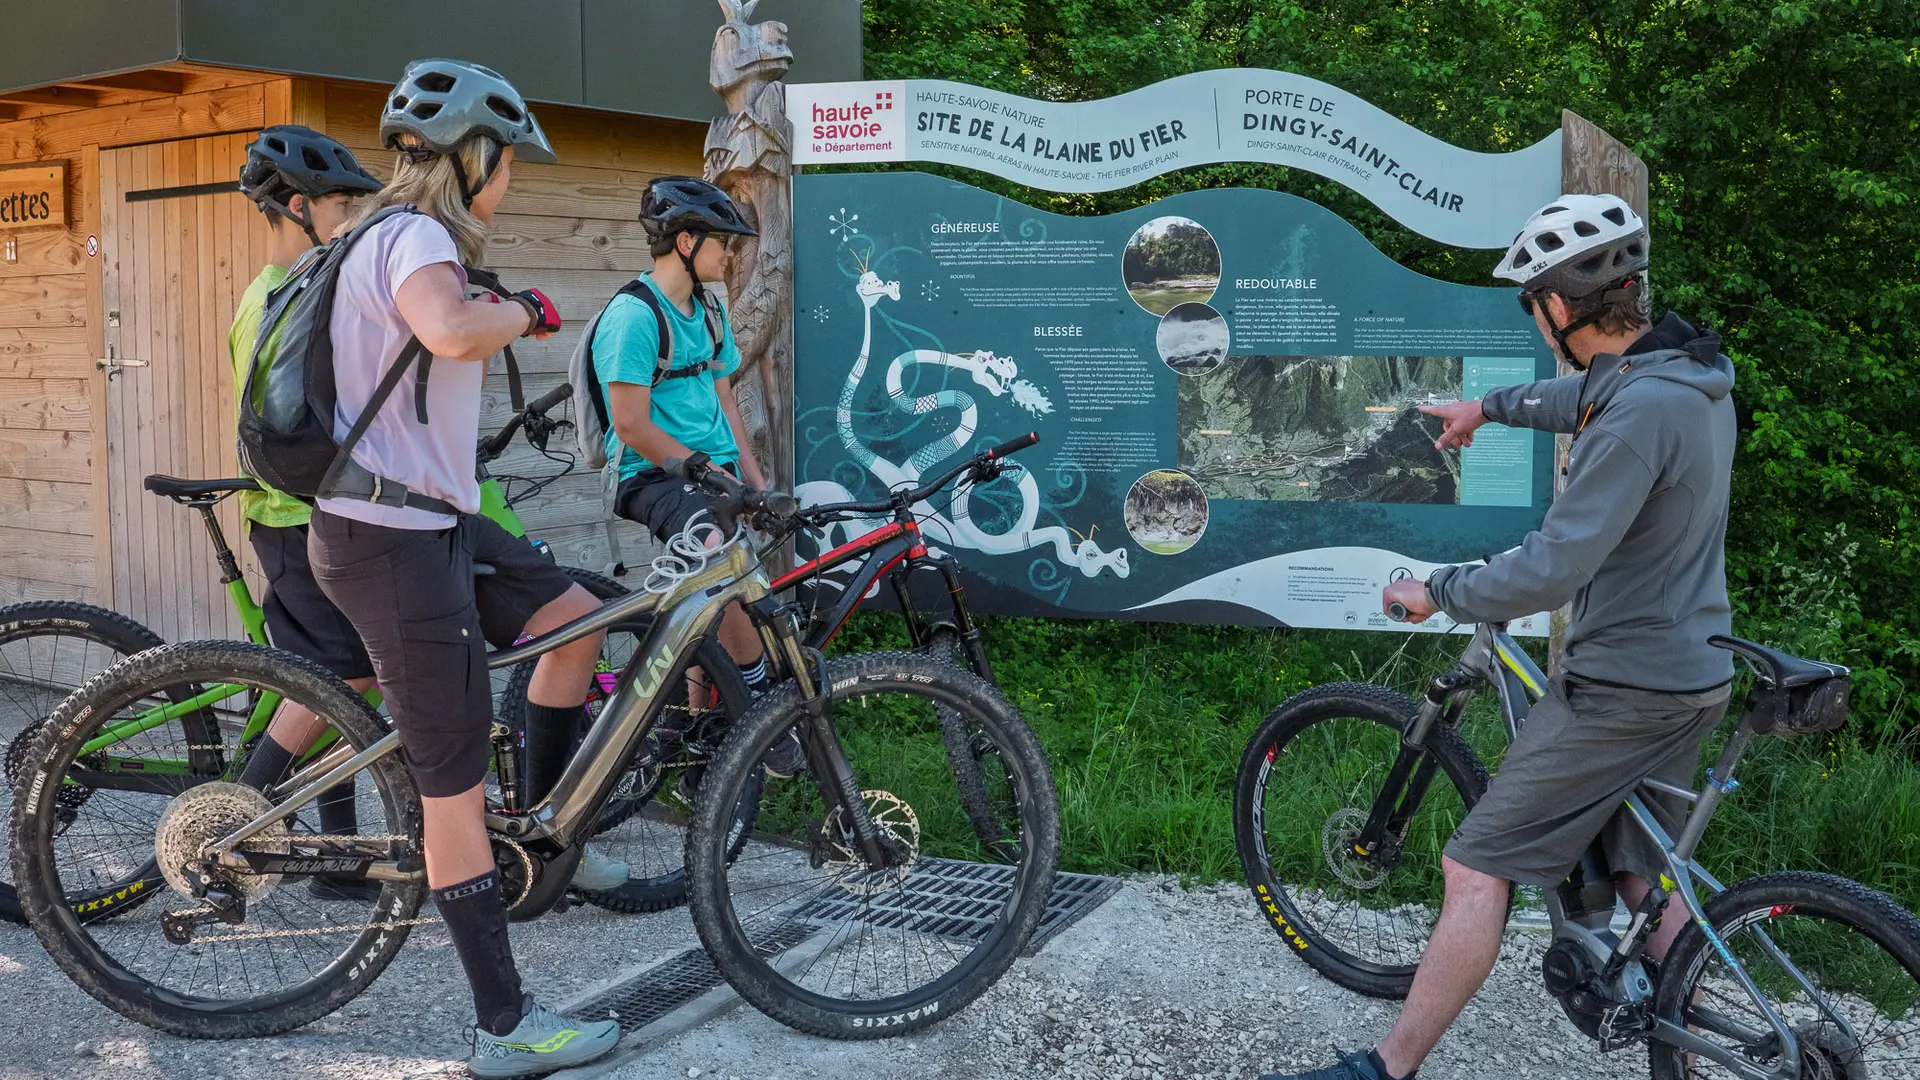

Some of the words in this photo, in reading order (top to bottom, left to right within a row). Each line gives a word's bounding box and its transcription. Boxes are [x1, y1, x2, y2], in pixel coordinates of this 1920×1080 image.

[812, 101, 873, 122] haute
[916, 92, 999, 113] HAUTE-SAVOIE
[1000, 105, 1045, 128] NATURE
[1245, 89, 1305, 109] PORTE
[1308, 97, 1336, 117] DE
[813, 122, 882, 140] savoie
[917, 111, 961, 134] SITE
[968, 117, 993, 142] DE
[999, 125, 1026, 153] LA
[1033, 137, 1103, 163] PLAINE
[1109, 137, 1136, 161] DU
[1139, 119, 1188, 152] FIER
[812, 143, 821, 153] le
[824, 141, 893, 153] Département
[920, 140, 961, 152] SENSITIVE
[961, 145, 997, 160] NATURAL
[997, 155, 1023, 170] AERAS
[1022, 163, 1032, 172] IN
[1032, 165, 1091, 181] HAUTE-SAVOIE
[1097, 170, 1113, 180] THE
[1114, 167, 1132, 179] FIER
[1132, 159, 1154, 173] RIVER
[1155, 150, 1179, 165] PLAIN
[1246, 139, 1328, 161] DINGY-SAINT-CLAIR
[1328, 154, 1373, 182] ENTRANCE
[1243, 113, 1464, 213] DINGY-SAINT-CLAIR
[0, 190, 50, 223] ettes
[931, 222, 1000, 234] GÉNÉREUSE
[1532, 260, 1548, 273] ZK1
[1235, 278, 1317, 289] REDOUTABLE
[1034, 324, 1083, 337] BLESSÉE
[633, 643, 674, 698] Liv
[1257, 884, 1309, 949] MAXXIS
[348, 895, 404, 981] MAXXIS
[853, 1001, 939, 1028] MAXXIS
